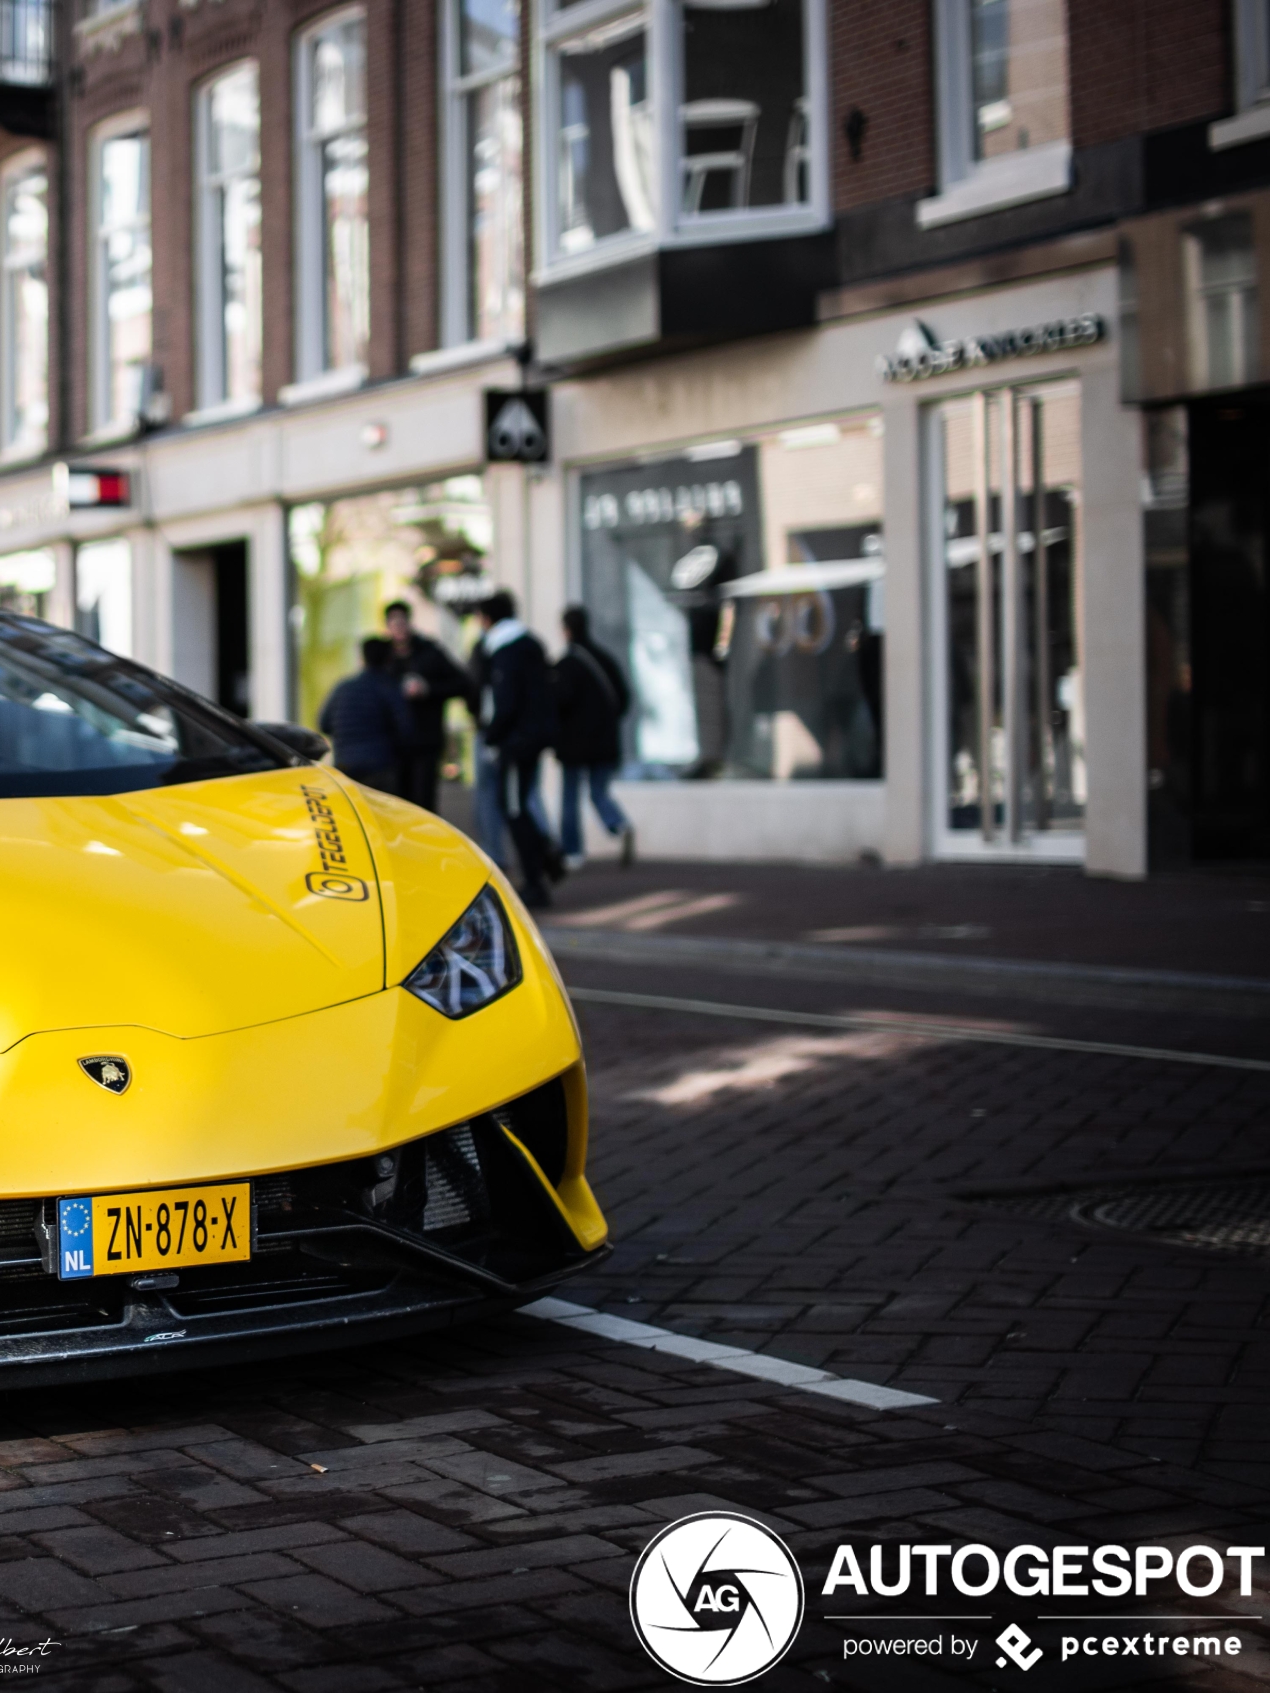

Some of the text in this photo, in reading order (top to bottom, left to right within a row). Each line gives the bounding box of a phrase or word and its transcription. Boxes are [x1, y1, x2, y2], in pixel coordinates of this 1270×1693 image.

[300, 784, 349, 873] TEGELDEPOT
[65, 1250, 91, 1272] NL
[106, 1196, 238, 1261] ZN-878-X
